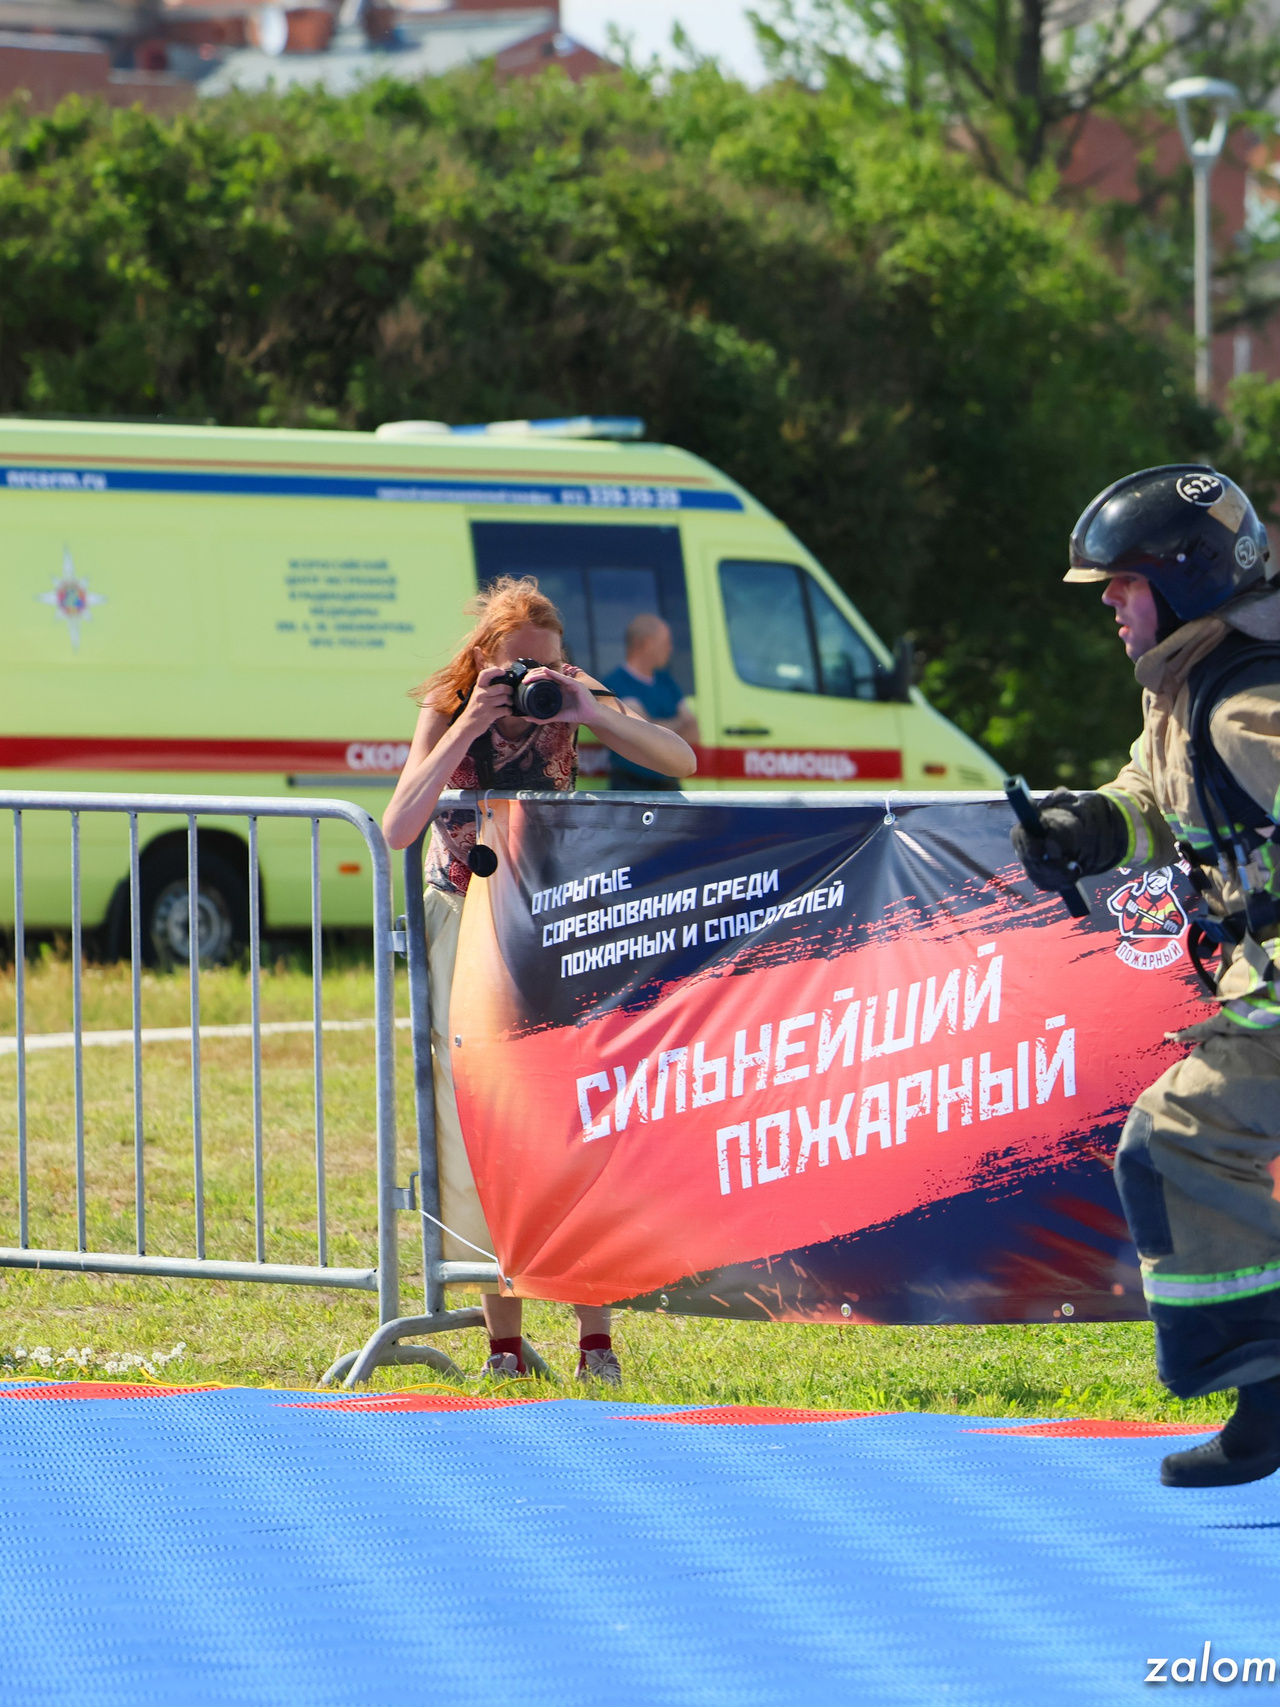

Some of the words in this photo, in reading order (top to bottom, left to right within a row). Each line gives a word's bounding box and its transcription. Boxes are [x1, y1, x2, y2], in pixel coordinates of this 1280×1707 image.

[346, 742, 410, 771] СКОР
[744, 751, 858, 781] ПОМОЩЬ
[531, 866, 632, 915] ОТКРЫТЫЕ
[542, 887, 698, 948] СОРЕВНОВАНИЯ
[702, 869, 780, 907] СРЕДИ
[561, 929, 677, 979] ПОЖАРНЫХ
[682, 923, 698, 948] И
[704, 880, 846, 944] СПАСАТЕЛЕЙ
[1117, 942, 1182, 968] ПОЖАРНЫЙ
[575, 941, 1004, 1144] СИЛЬНЕЙШИЙ
[715, 1014, 1077, 1196] ПОЖАРНЫЙ
